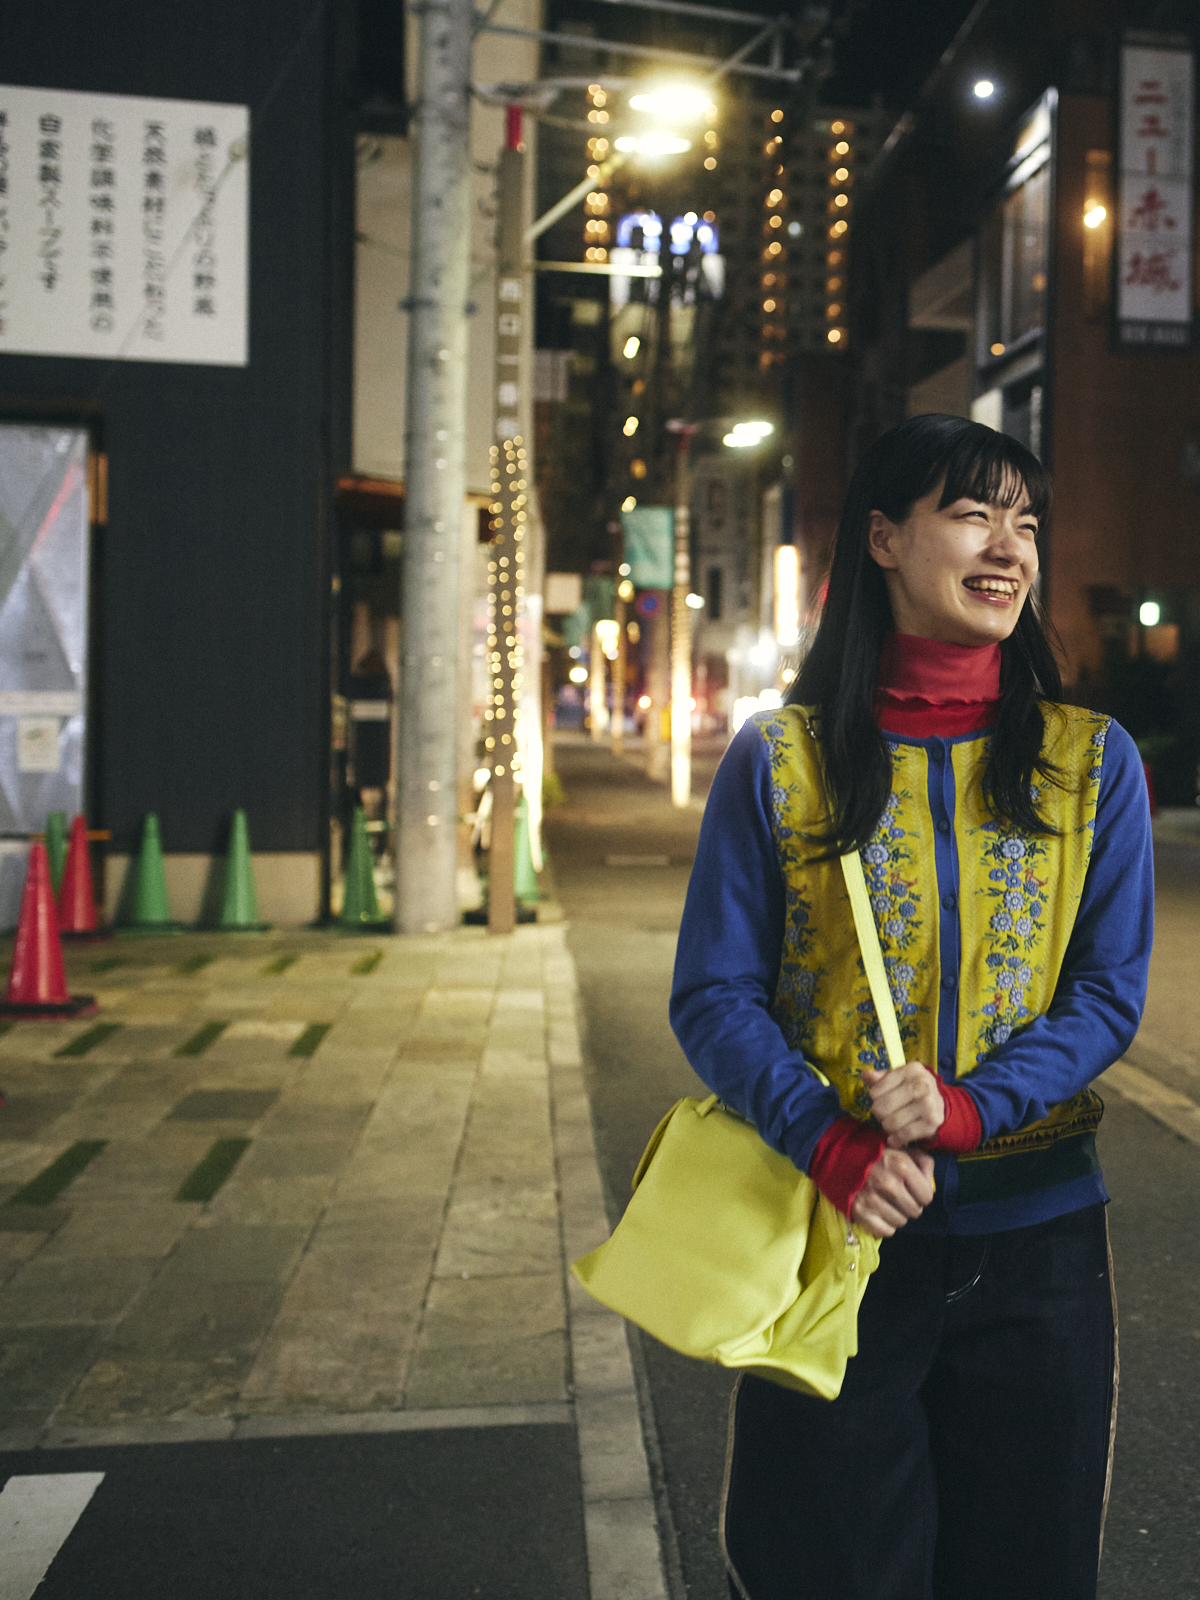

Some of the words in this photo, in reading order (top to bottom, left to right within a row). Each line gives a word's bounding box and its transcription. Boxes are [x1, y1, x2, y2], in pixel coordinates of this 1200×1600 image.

[38, 112, 62, 293] 自家製スープです
[90, 118, 115, 333] 化学調味料不使用の
